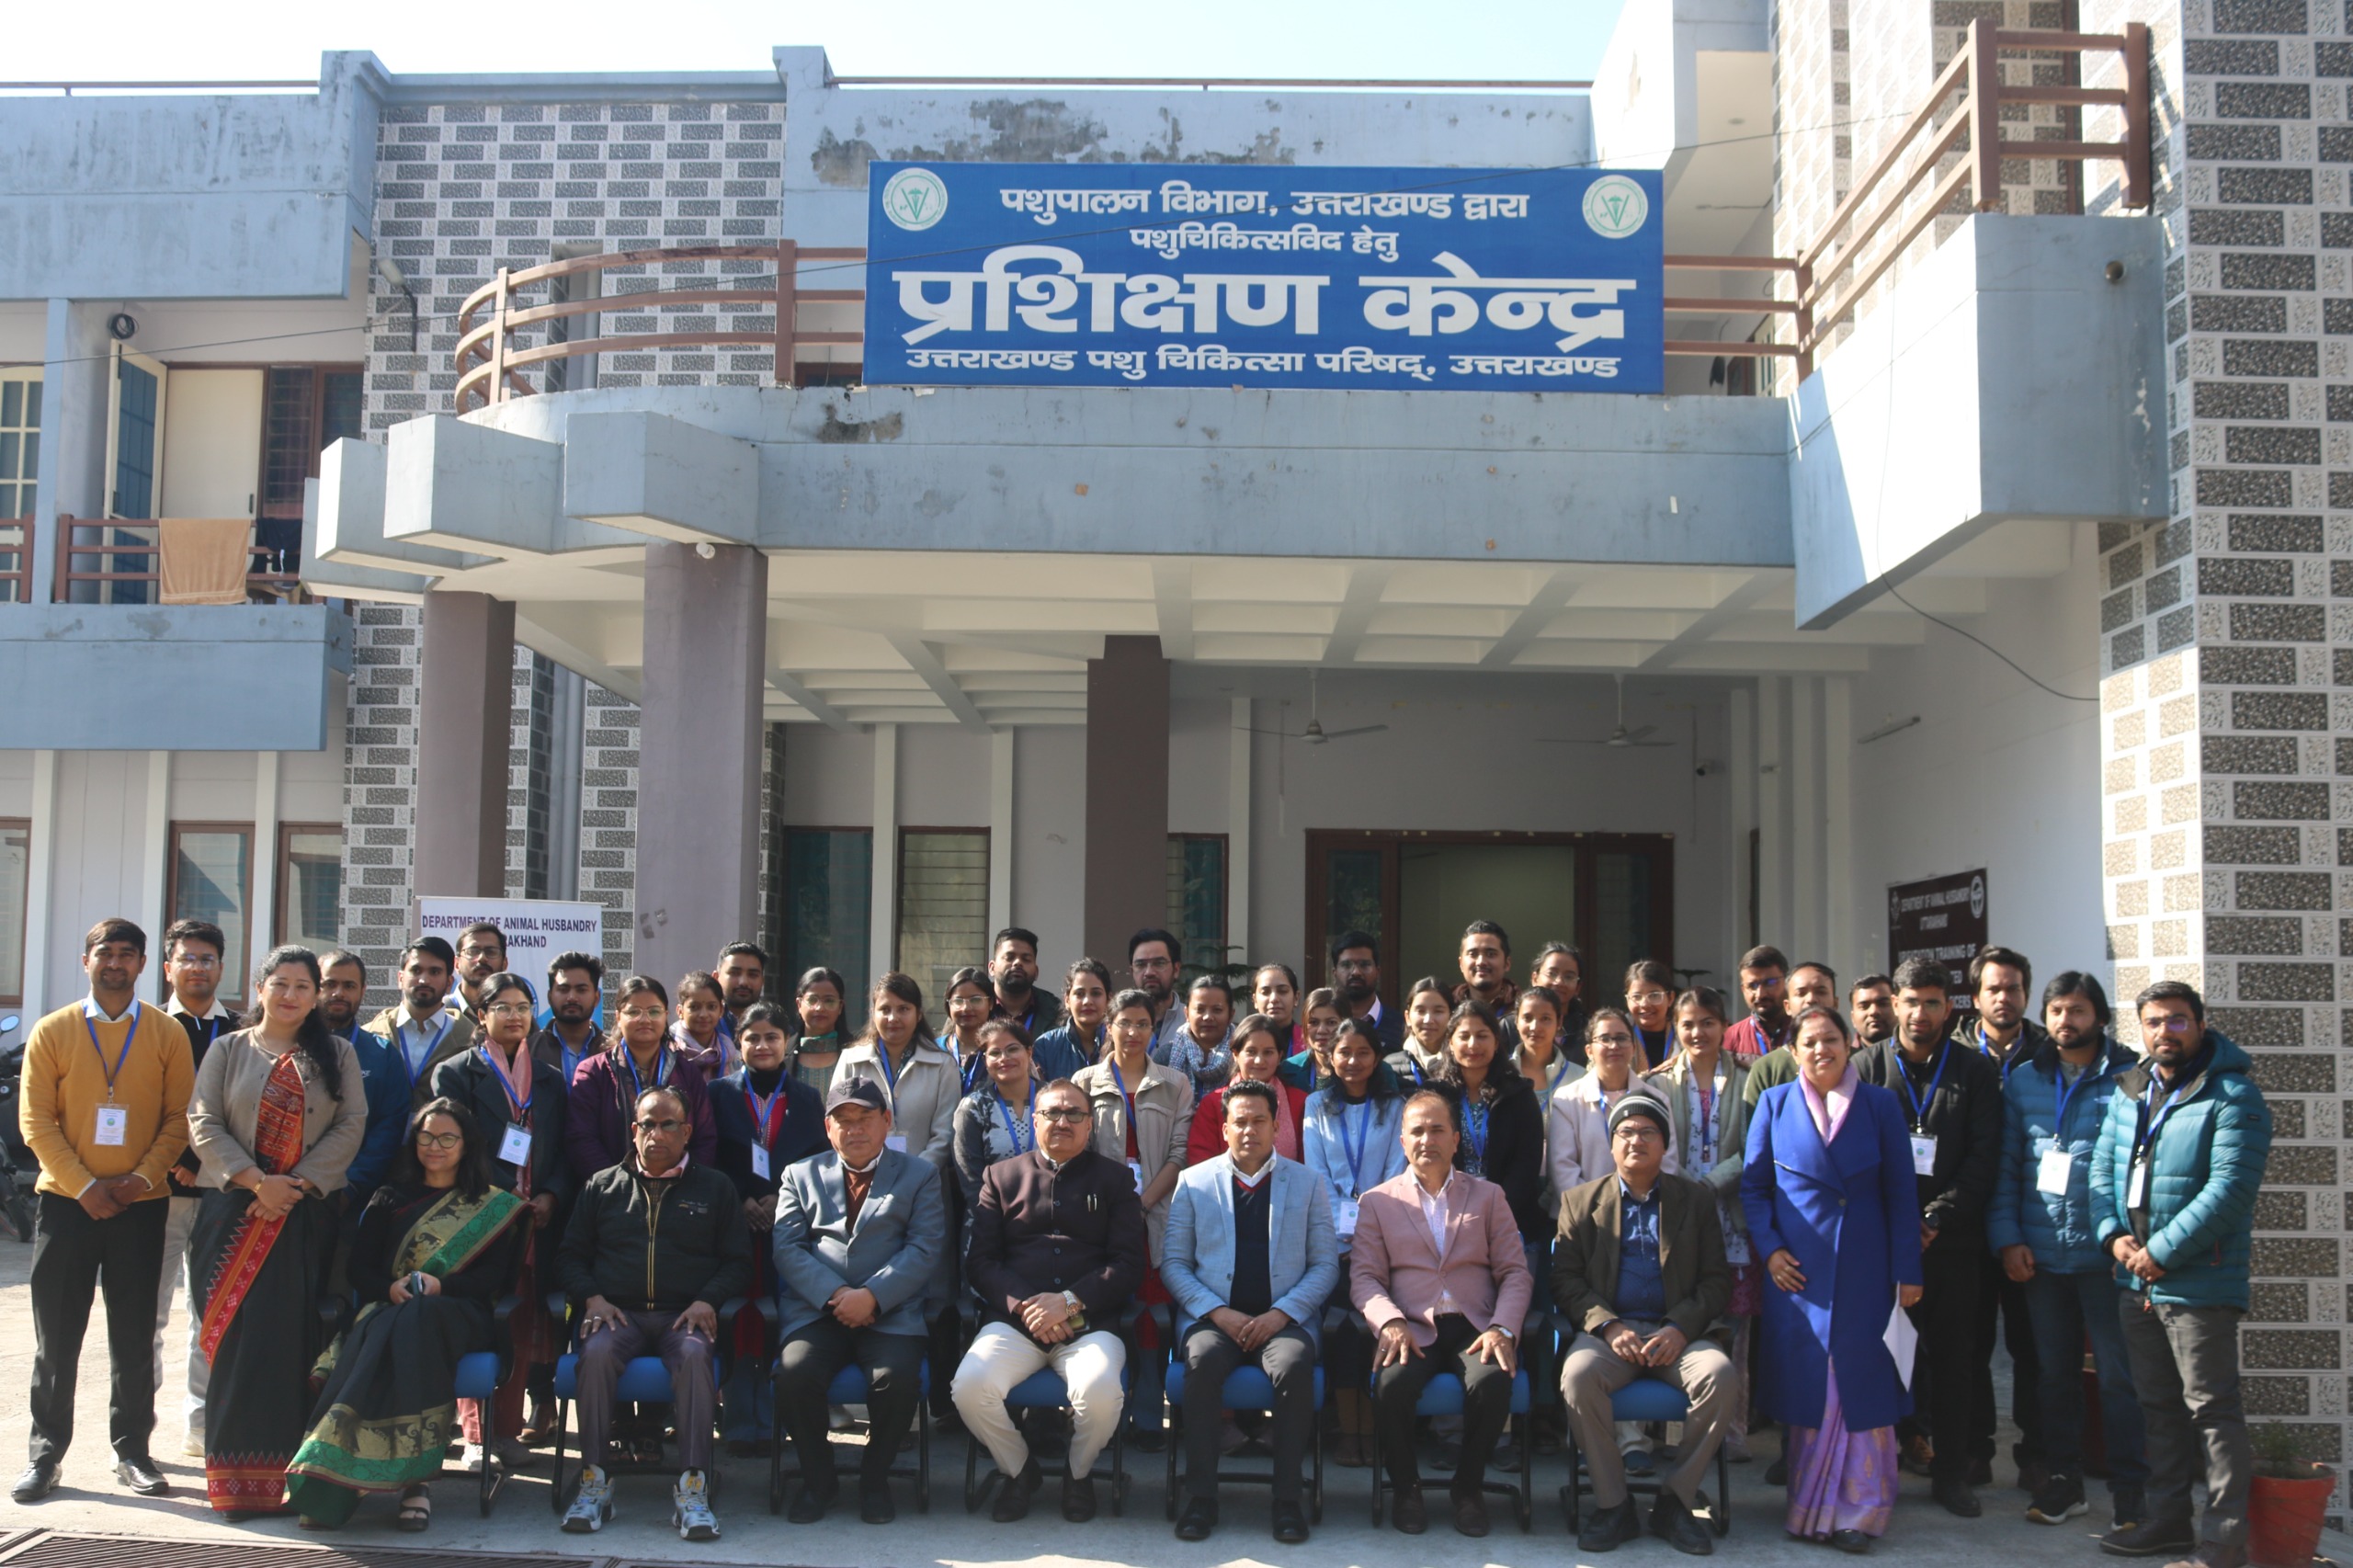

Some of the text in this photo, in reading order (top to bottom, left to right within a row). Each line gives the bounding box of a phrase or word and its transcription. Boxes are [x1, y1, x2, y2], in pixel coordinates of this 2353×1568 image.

[1000, 179, 1530, 225] पशुपालन विभाग, उत्तराखण्ड द्वारा
[1129, 221, 1400, 263] पशुचिकित्सविद हेतु
[892, 244, 1637, 354] प्रशिक्षण केन्द्र
[905, 343, 1621, 381] उत्तराखण्ड पशु चिकित्सा परिषद्, उत्तराखण्ड
[488, 916, 501, 928] OF
[504, 917, 539, 931] ANIMAL
[541, 918, 597, 932] HUSBANDRY
